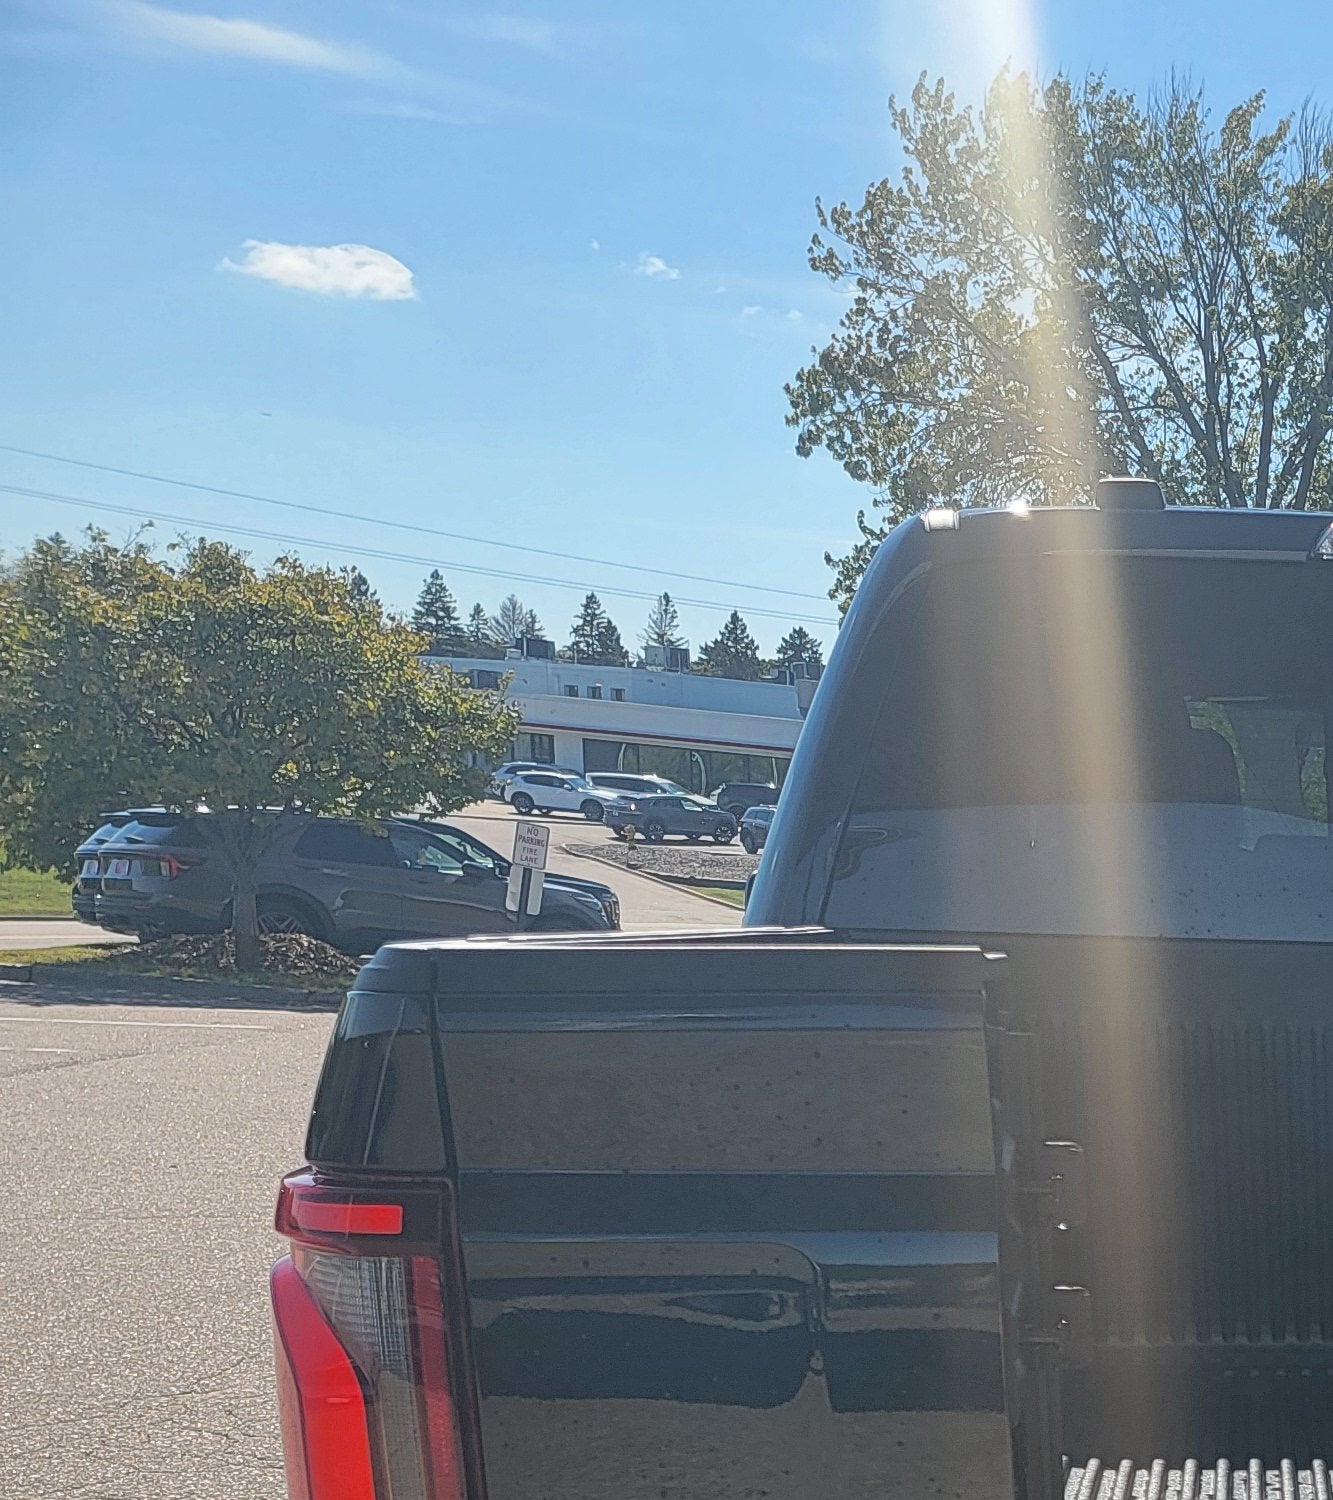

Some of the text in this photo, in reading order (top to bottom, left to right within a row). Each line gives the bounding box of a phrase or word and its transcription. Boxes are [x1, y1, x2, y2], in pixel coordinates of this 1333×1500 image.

[527, 826, 539, 837] NO
[518, 834, 545, 848] PARKING
[522, 846, 538, 856] FIRE
[520, 854, 538, 864] LANE
